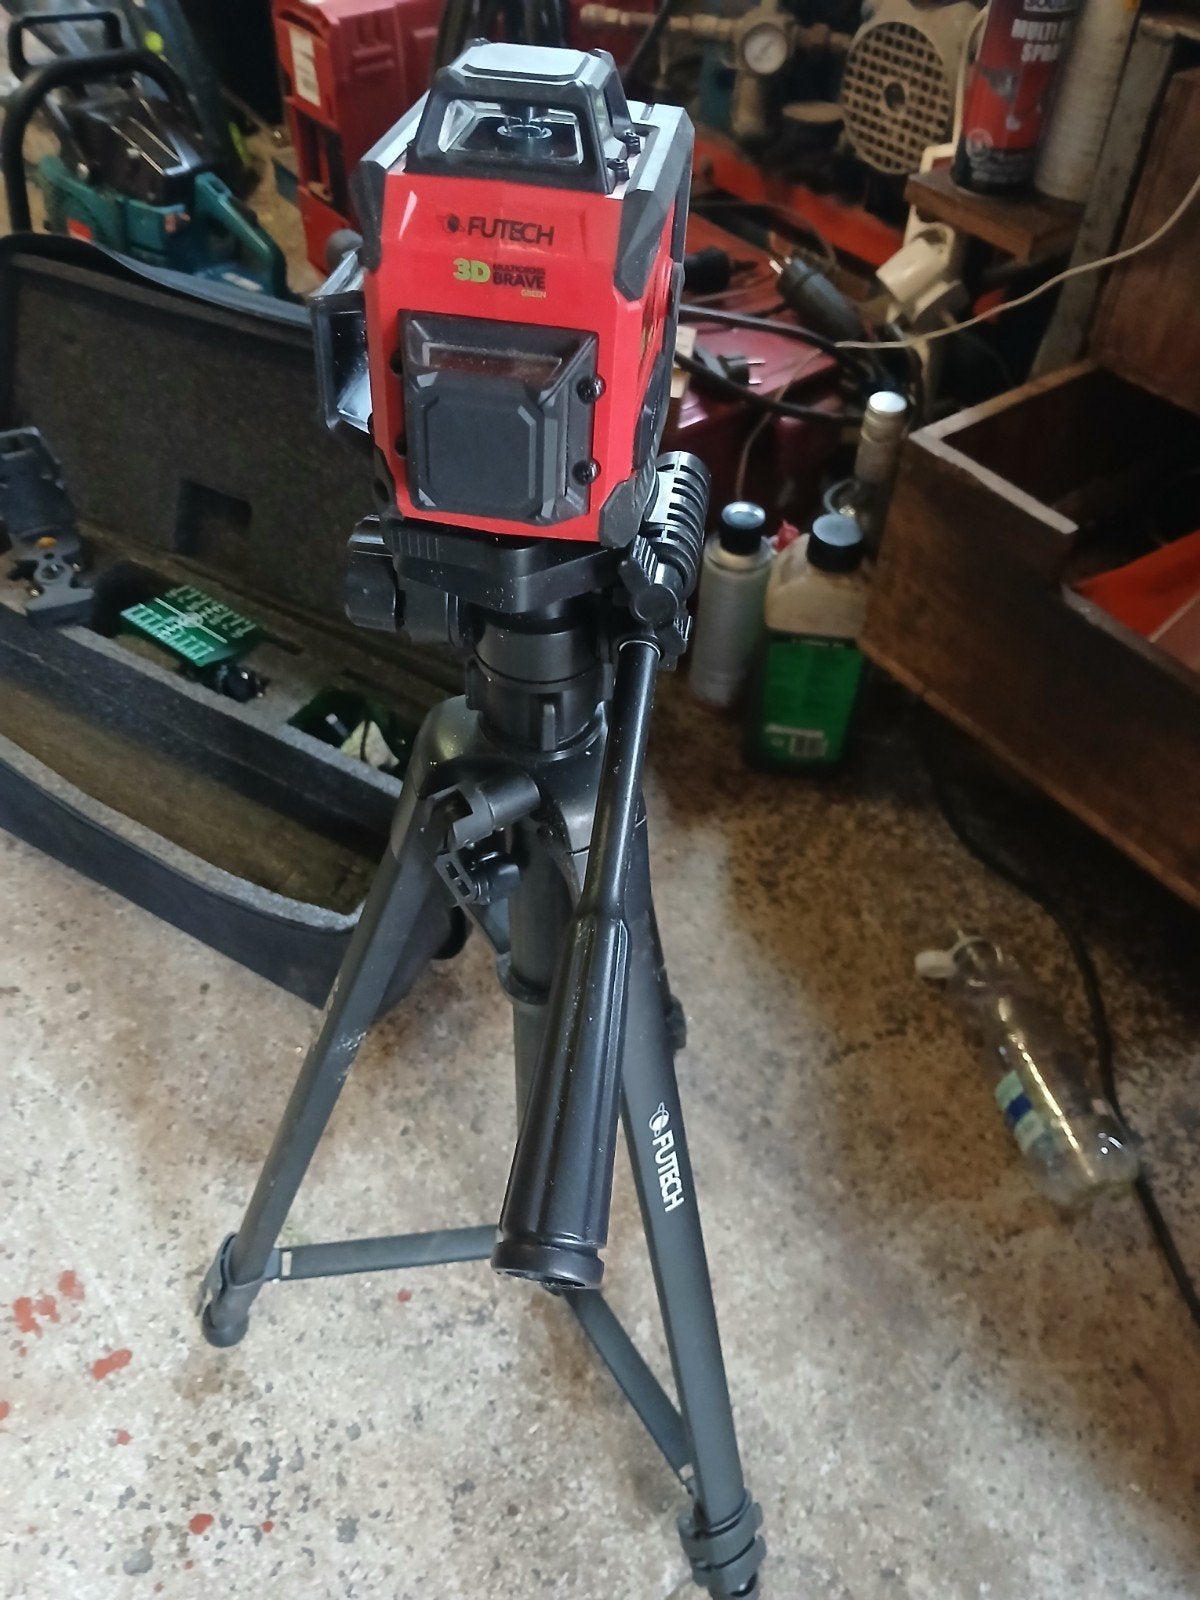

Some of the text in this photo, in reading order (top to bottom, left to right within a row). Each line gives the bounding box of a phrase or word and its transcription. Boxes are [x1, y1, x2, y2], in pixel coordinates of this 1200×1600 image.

[468, 216, 554, 246] FUTECH
[453, 258, 491, 283] 3D
[493, 271, 545, 290] BRAVE
[652, 1129, 685, 1212] FUTECH
